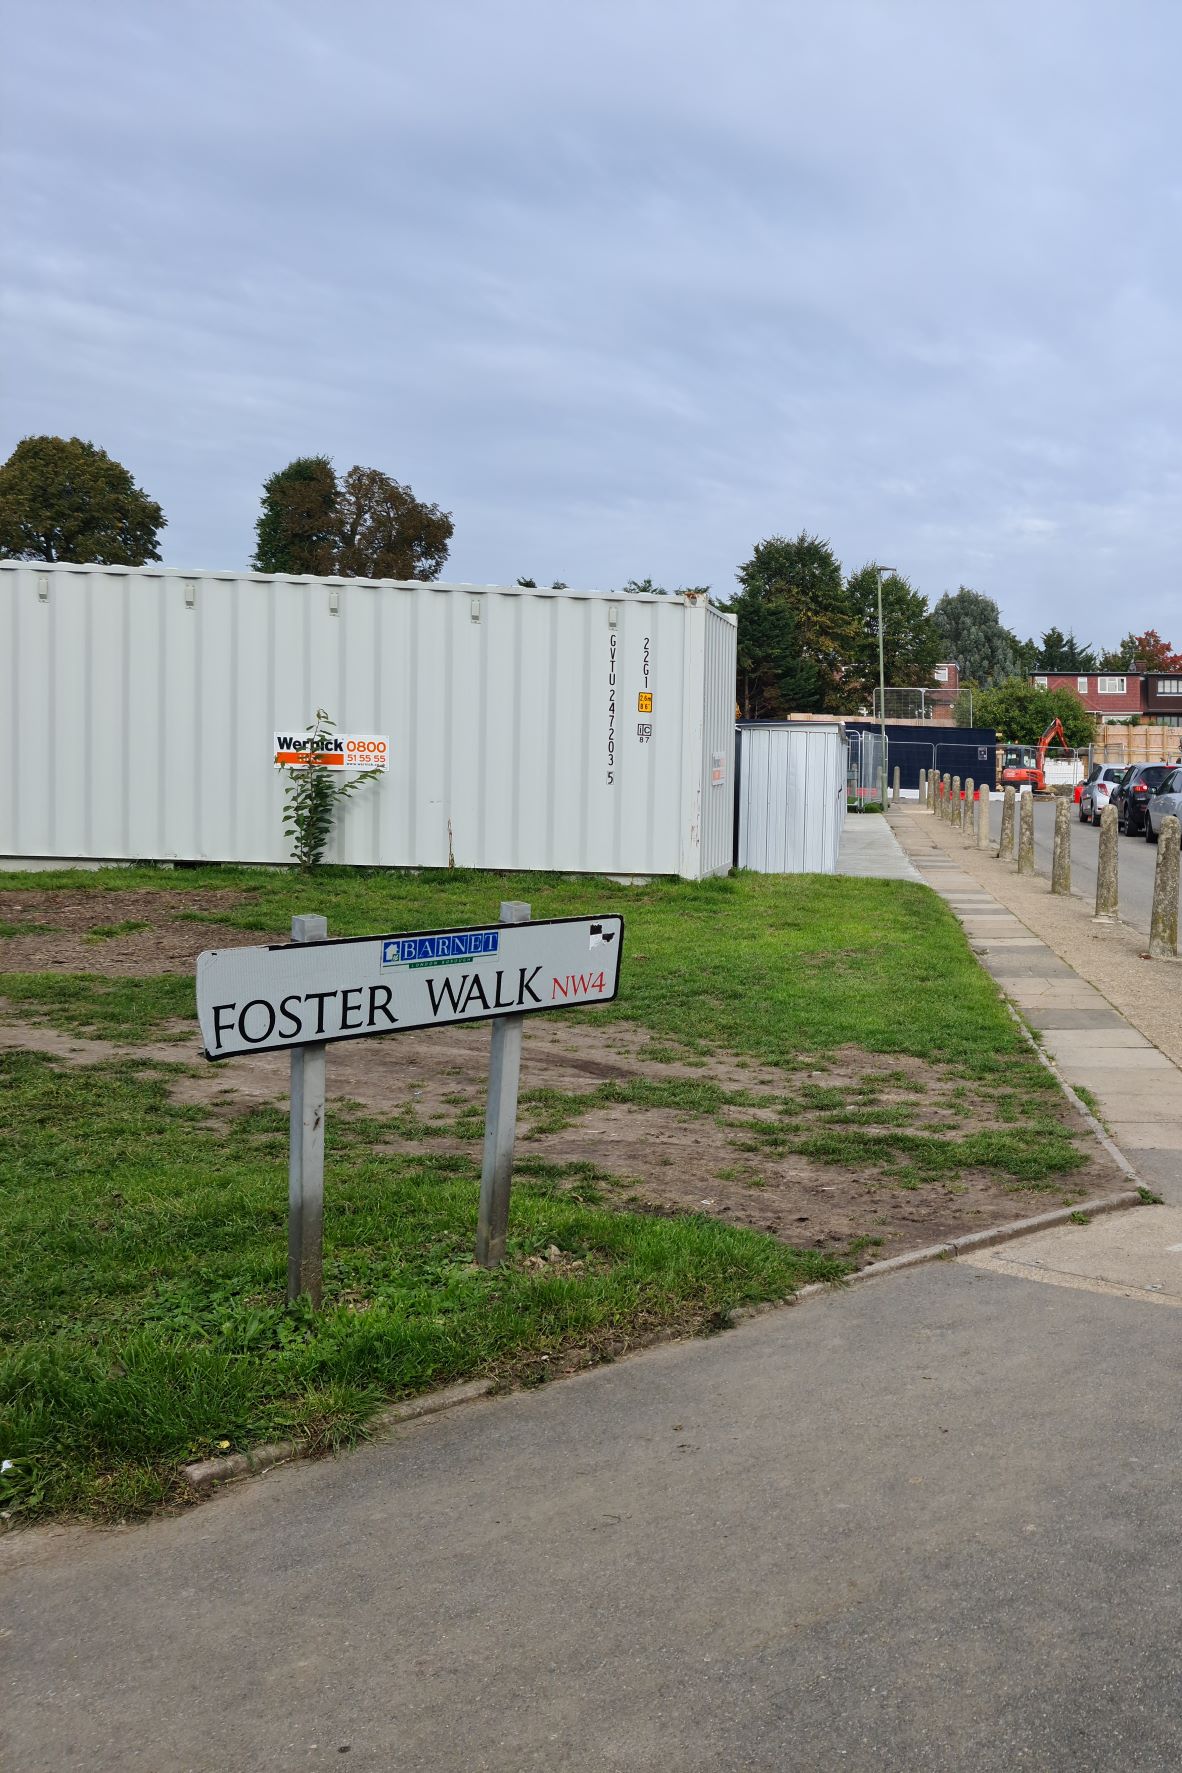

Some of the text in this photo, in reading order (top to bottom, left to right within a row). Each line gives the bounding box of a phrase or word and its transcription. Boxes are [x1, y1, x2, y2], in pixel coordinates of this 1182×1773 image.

[346, 740, 387, 753] 0800
[347, 754, 386, 763] 51 55 55
[403, 934, 498, 959] BARNET
[441, 957, 471, 965] BOROUGH
[212, 965, 607, 1049] FOSTER WALK NW4
